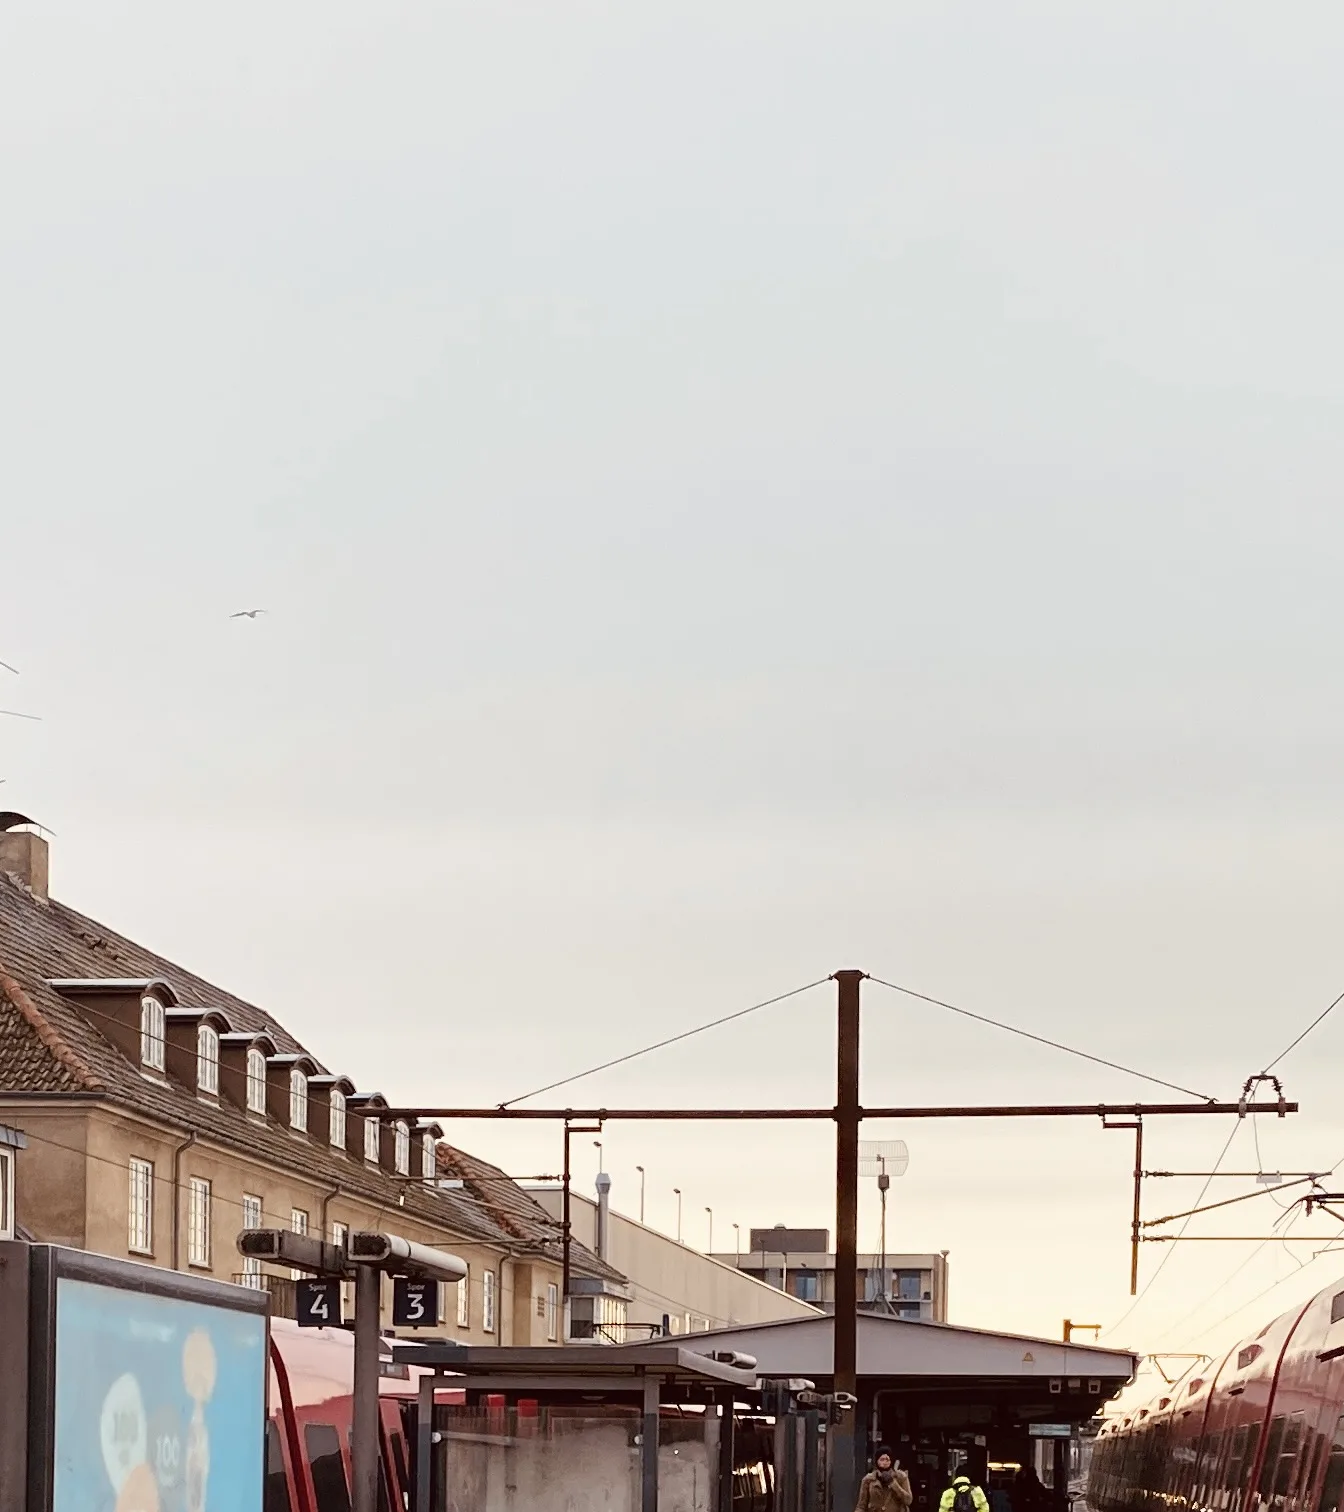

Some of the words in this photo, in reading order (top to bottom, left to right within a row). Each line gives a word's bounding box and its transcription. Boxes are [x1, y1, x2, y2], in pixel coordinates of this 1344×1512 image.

[307, 1282, 328, 1293] Spor
[406, 1282, 426, 1292] Spor
[309, 1293, 329, 1320] 4
[406, 1293, 425, 1320] 3
